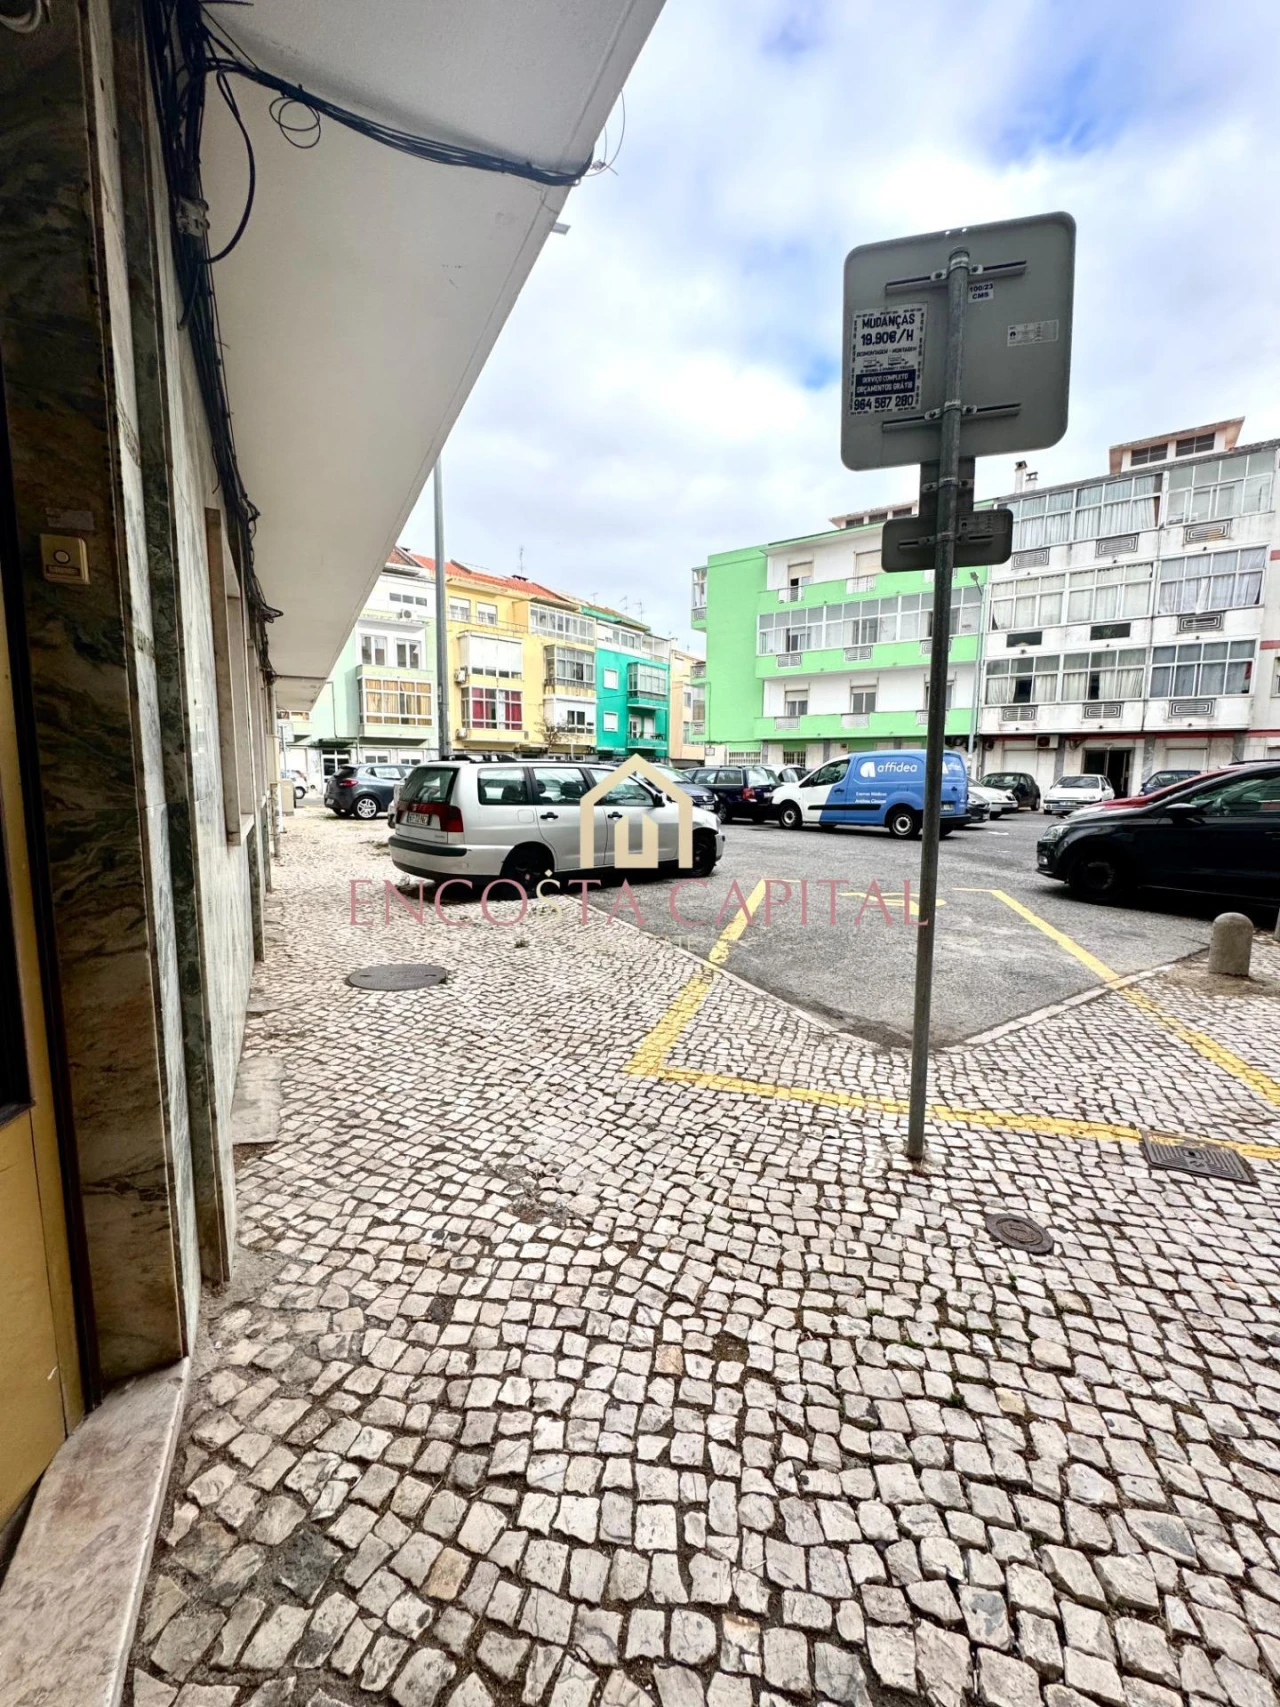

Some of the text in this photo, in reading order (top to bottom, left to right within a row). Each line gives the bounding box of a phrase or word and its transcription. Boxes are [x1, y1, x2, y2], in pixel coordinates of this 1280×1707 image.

[972, 292, 989, 300] CMS
[862, 313, 915, 329] MUDANÇAS
[860, 328, 914, 346] 19.90€/H
[862, 373, 908, 384] SERVIÇO COMPLETO
[854, 398, 872, 411] 964
[874, 396, 893, 409] 587
[894, 394, 914, 407] 280
[877, 761, 919, 773] affidea
